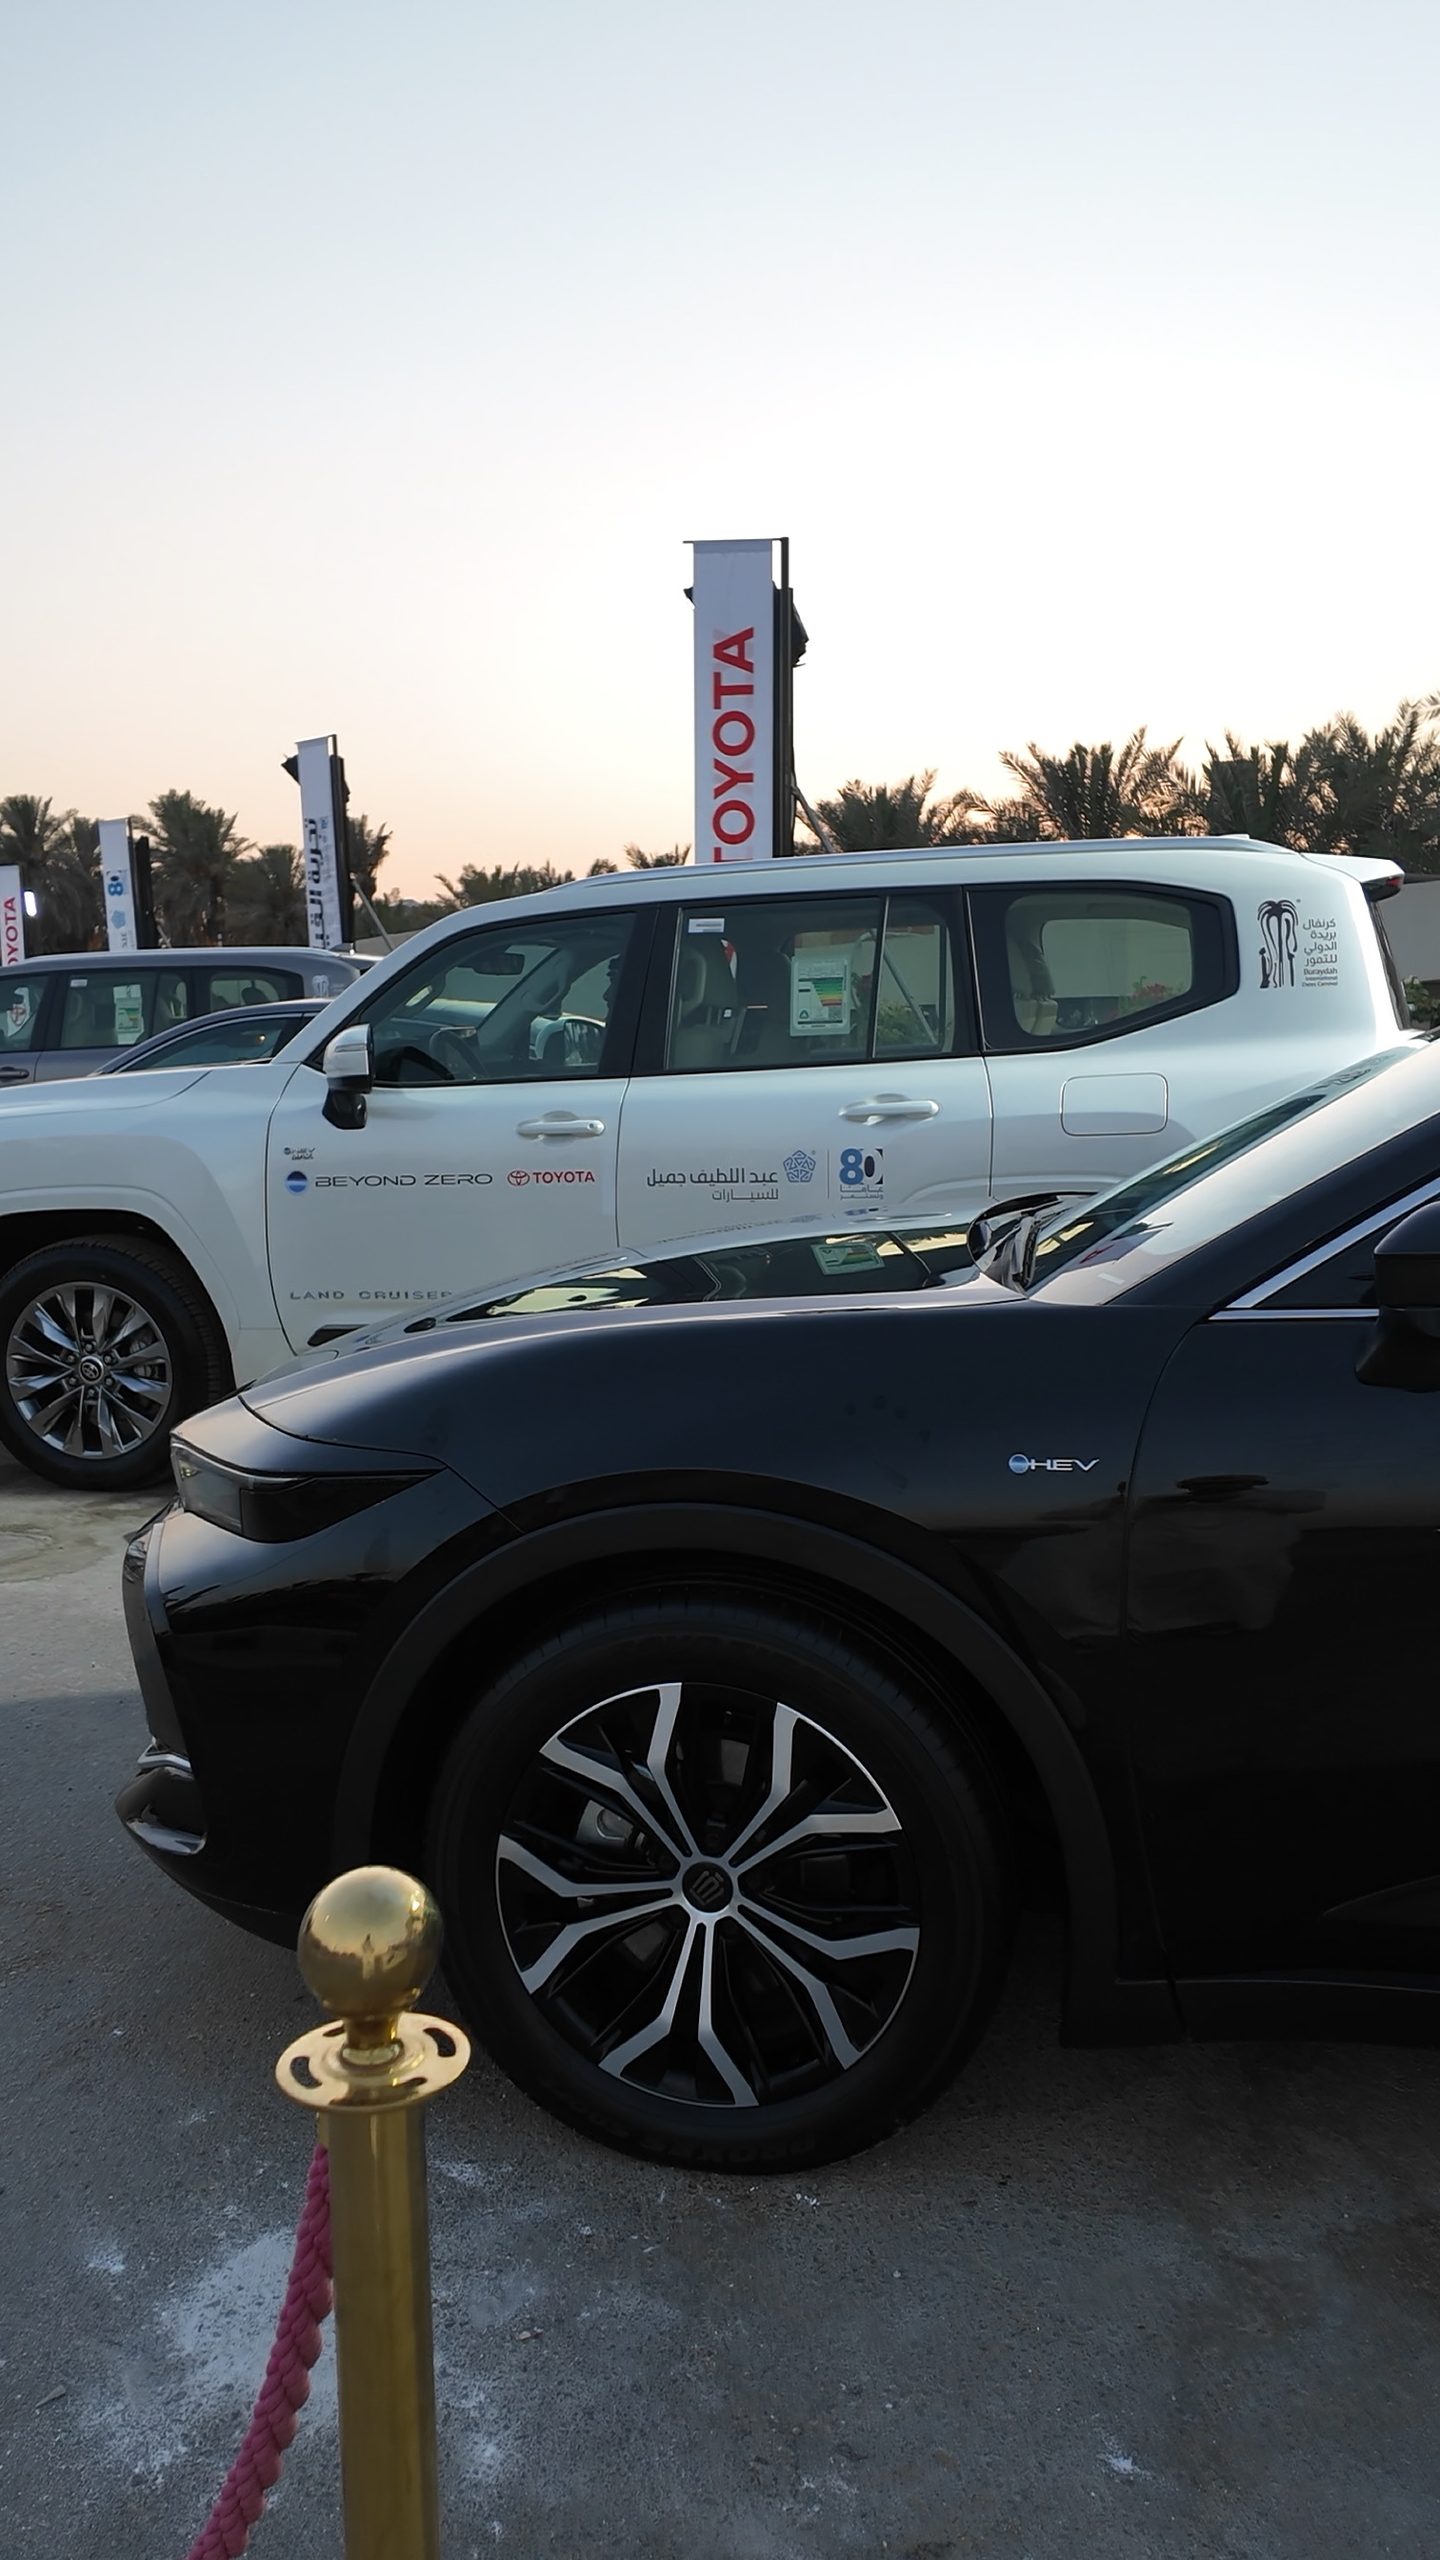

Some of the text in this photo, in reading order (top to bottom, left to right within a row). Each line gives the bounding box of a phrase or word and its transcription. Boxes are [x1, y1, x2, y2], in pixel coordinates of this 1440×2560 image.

[1302, 918, 1336, 930] كرنفال
[1310, 930, 1337, 941] بريدة
[1303, 941, 1337, 955] الدولي
[1304, 954, 1338, 967] للتمور
[839, 1148, 884, 1185] 80
[315, 1173, 493, 1188] BEYOND ZERO
[532, 1170, 596, 1184] TOYOTA
[646, 1167, 779, 1187] عبد اللطيف جميل
[290, 1290, 345, 1300] LAND
[1029, 1458, 1100, 1472] HEV
